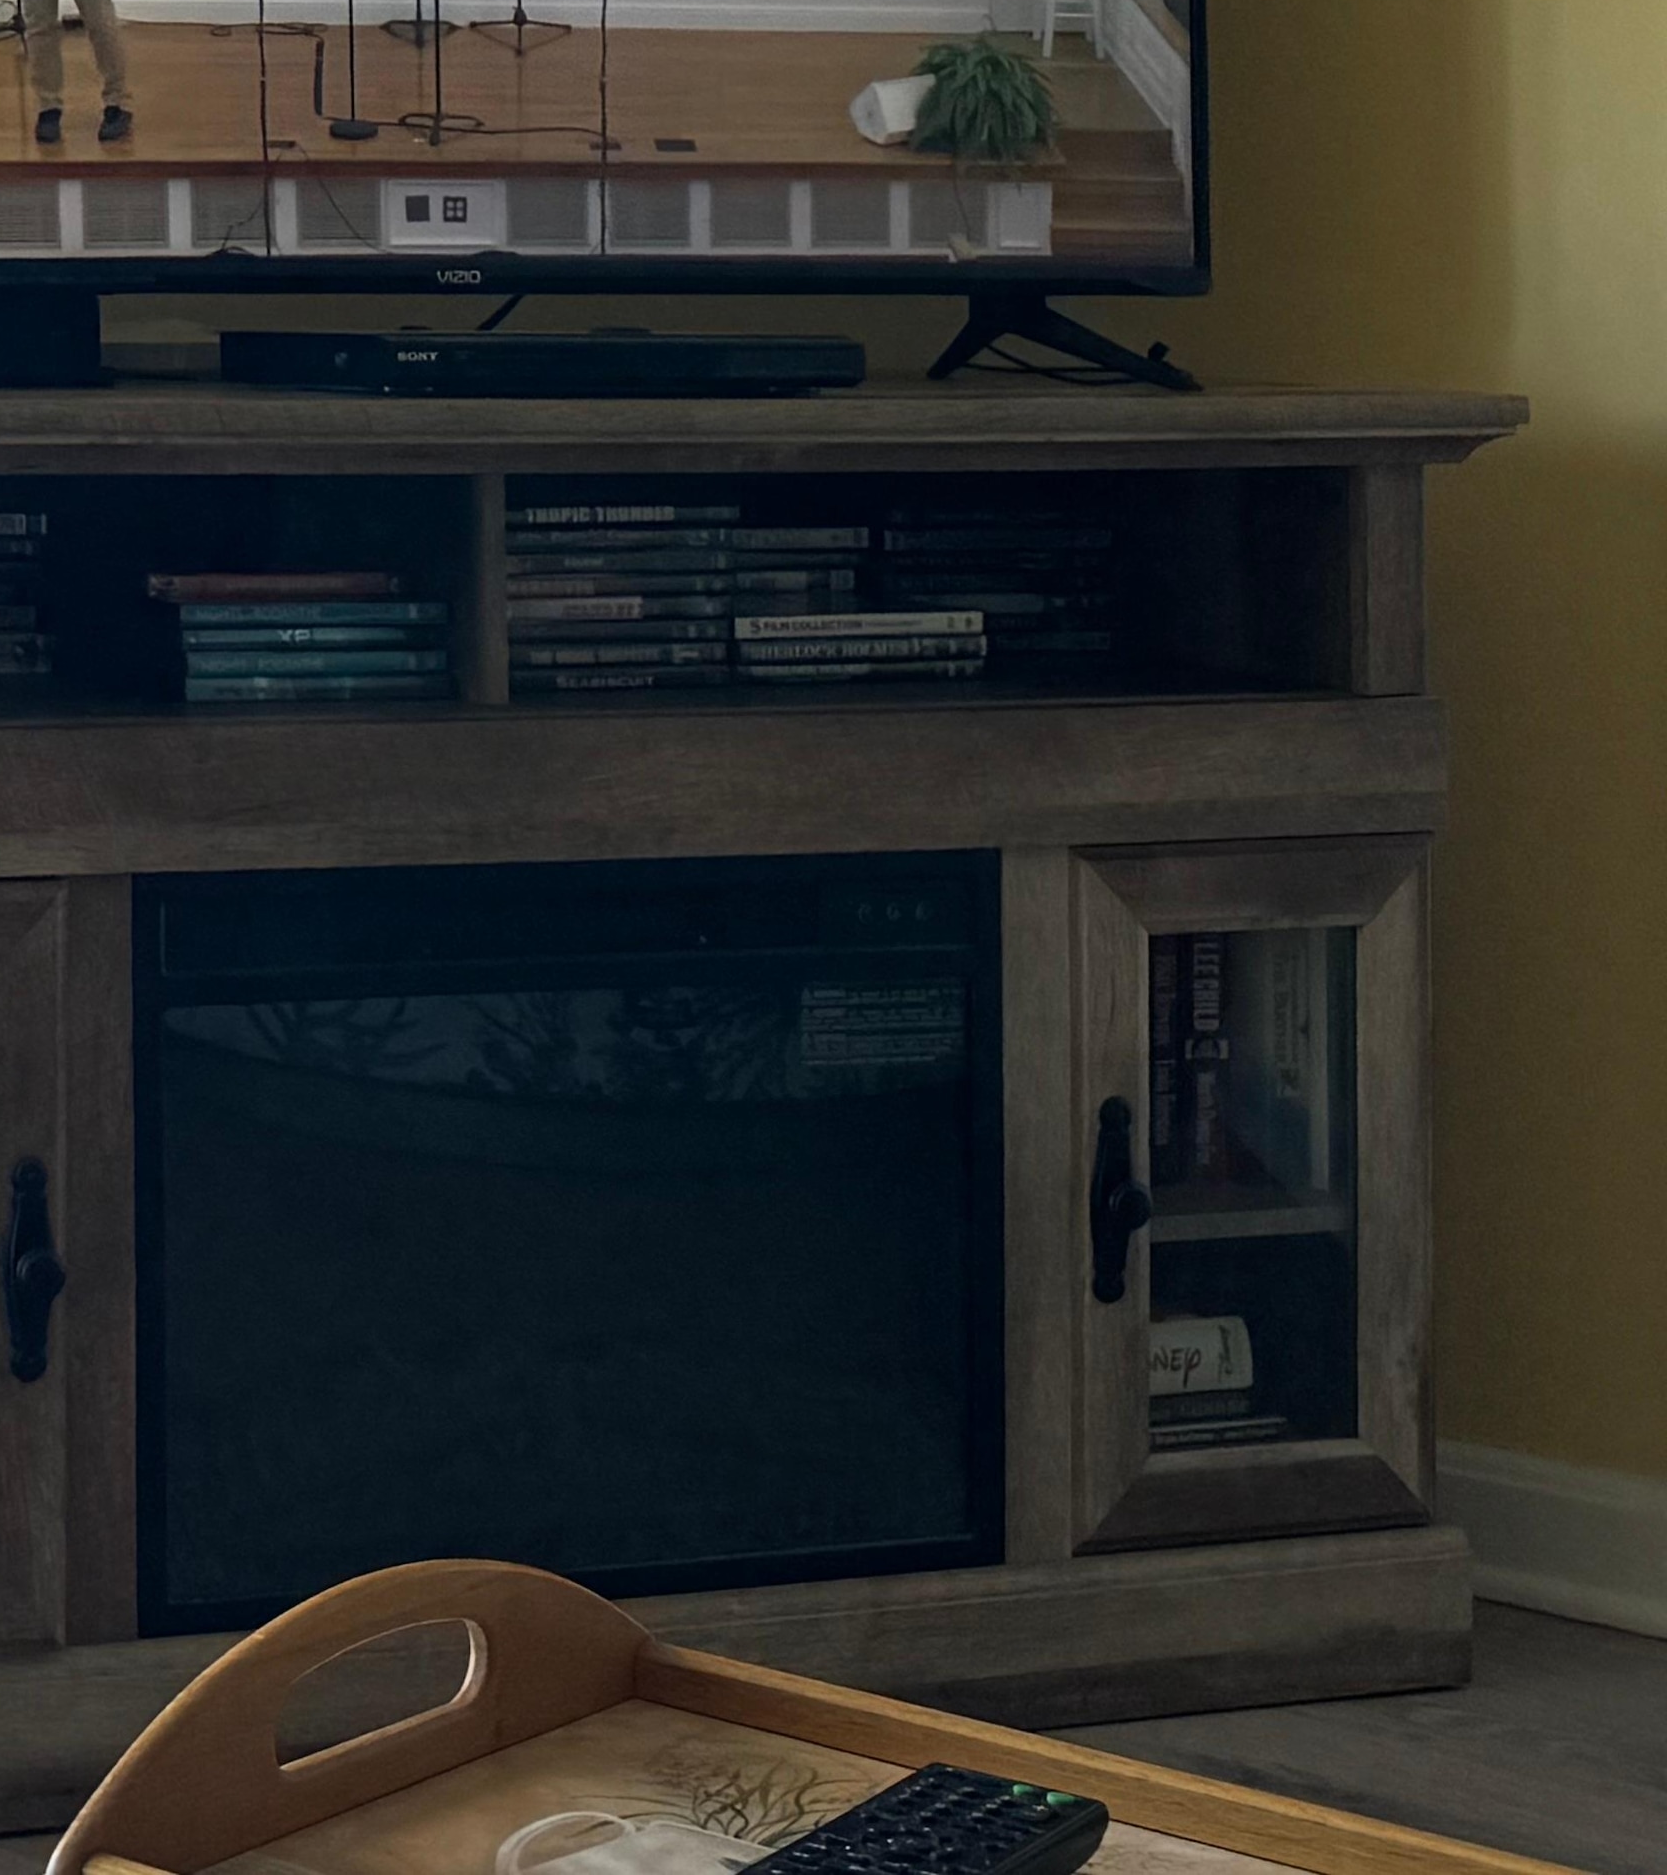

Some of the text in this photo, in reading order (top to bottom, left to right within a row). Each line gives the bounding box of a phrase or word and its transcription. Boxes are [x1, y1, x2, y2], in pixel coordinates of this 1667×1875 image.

[436, 270, 481, 284] VIZIO
[397, 351, 439, 361] SONY
[1193, 978, 1220, 1032] CHILD
